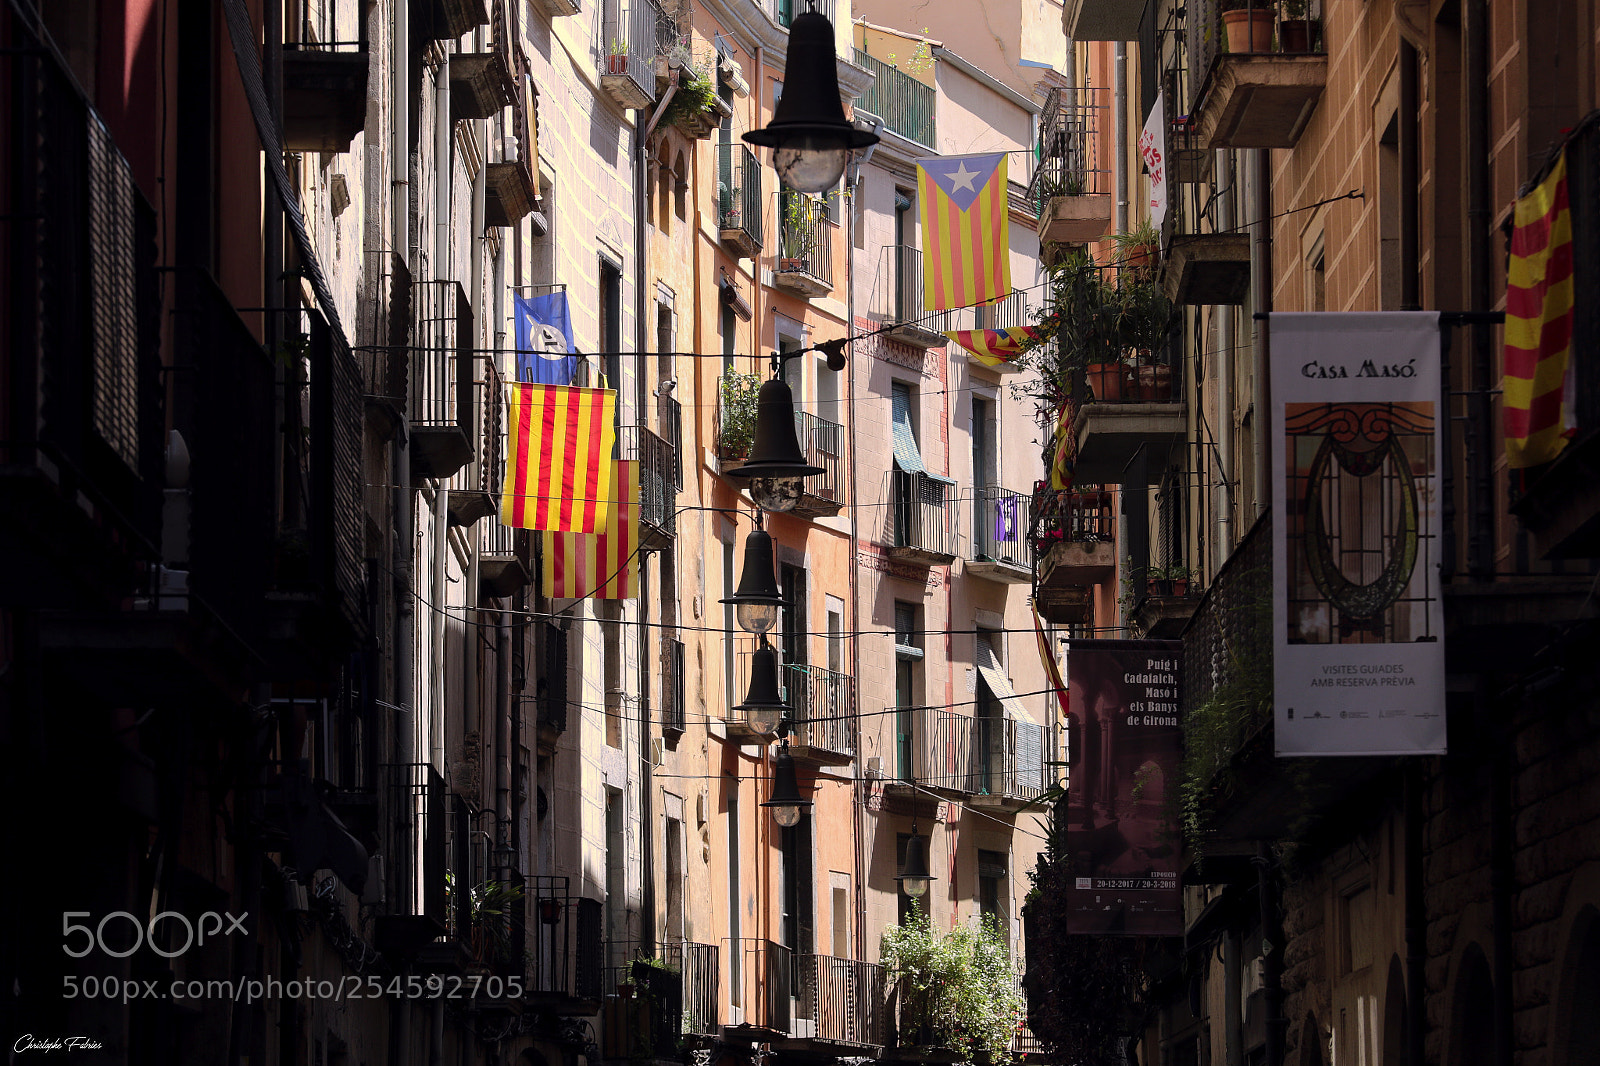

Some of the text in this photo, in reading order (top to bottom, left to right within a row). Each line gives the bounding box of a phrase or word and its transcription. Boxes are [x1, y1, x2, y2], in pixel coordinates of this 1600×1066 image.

[1147, 659, 1178, 671] Puig i
[1322, 664, 1404, 674] VISITES GUIADES
[1124, 673, 1178, 685] Cadafalch,
[1310, 676, 1415, 687] AMB RESERVA PRÈVIA
[1145, 687, 1178, 698] Masó i
[1130, 701, 1178, 713] els Banys
[1127, 716, 1177, 726] de Girona
[1097, 880, 1133, 888] 20-12-2017
[1136, 880, 1140, 888] /
[1142, 880, 1176, 889] 20-3-2018
